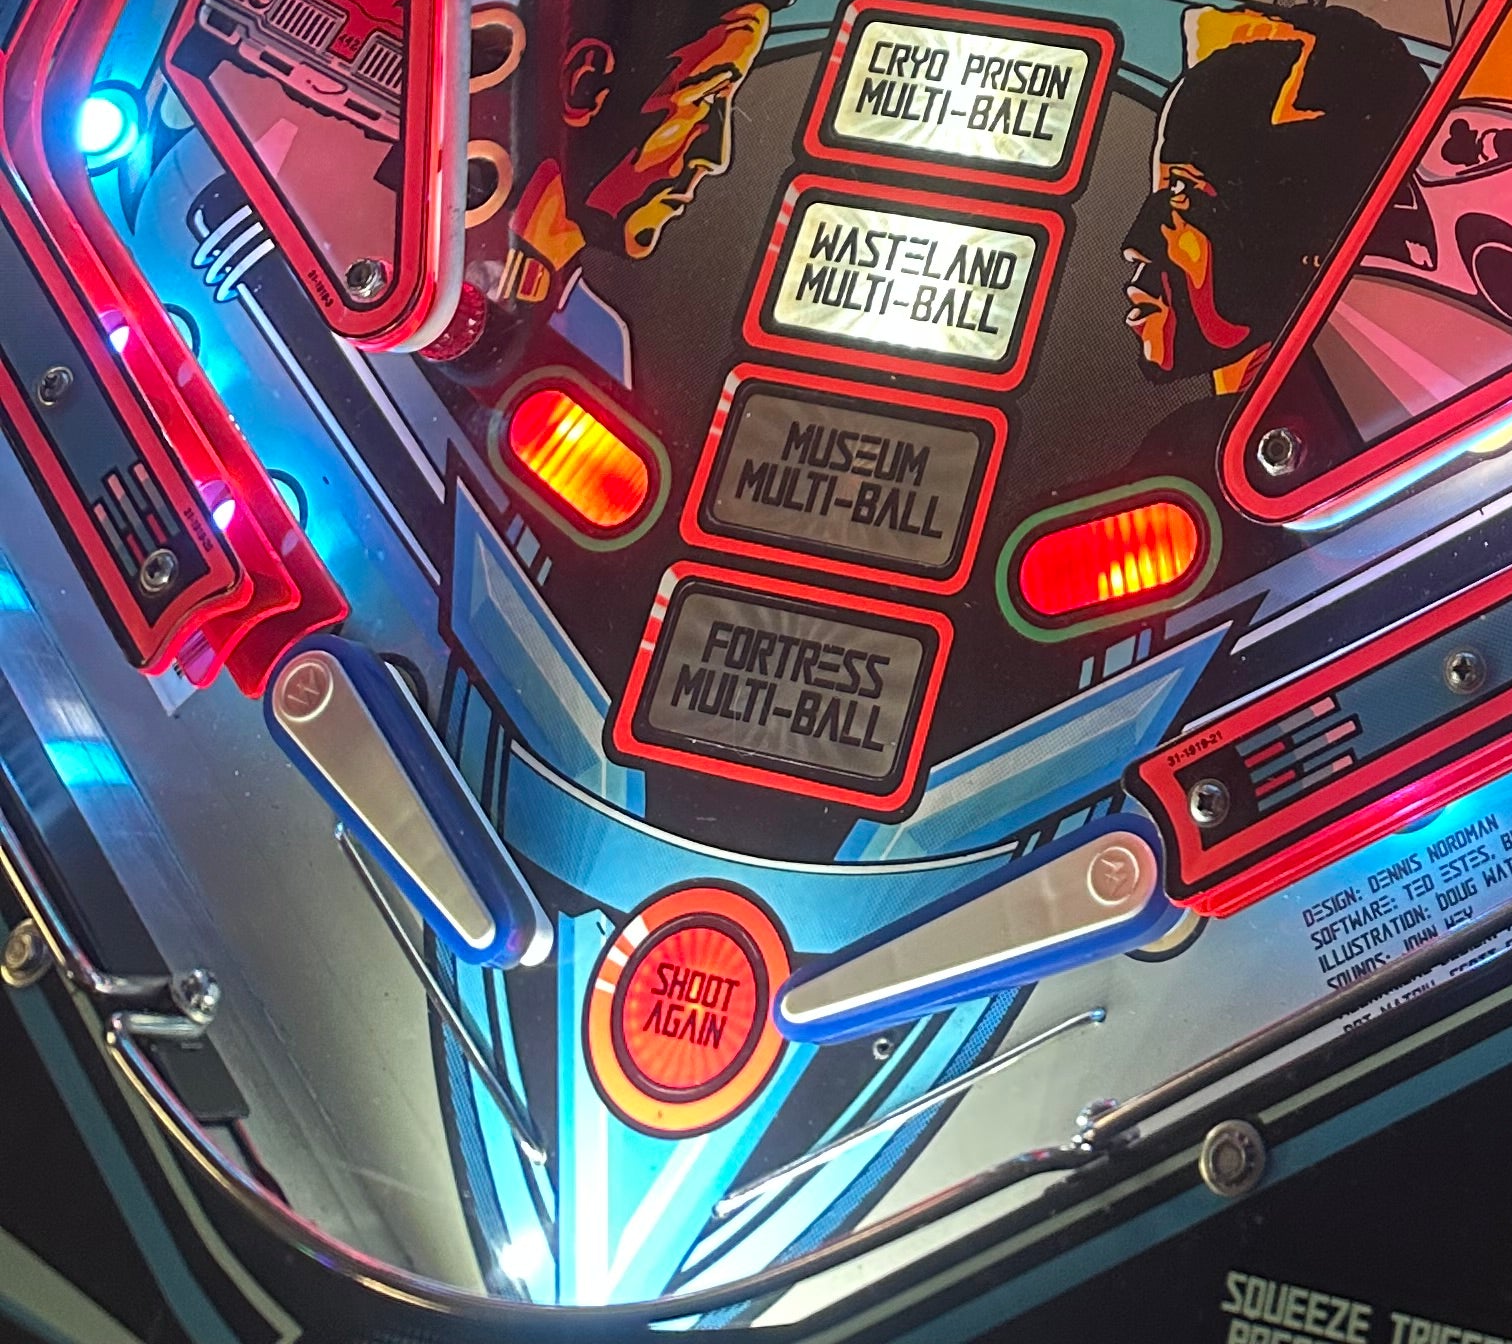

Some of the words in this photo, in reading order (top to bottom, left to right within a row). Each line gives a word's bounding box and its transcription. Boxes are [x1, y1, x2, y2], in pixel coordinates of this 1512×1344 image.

[867, 40, 950, 82] CRYO
[960, 52, 1073, 100] PRISON
[855, 77, 1054, 140] MULTI-BALL
[809, 222, 1018, 290] WASTELAND
[795, 268, 999, 333] MULTI-BALL
[780, 420, 931, 487] MUSEUM
[735, 458, 943, 539] MULTI-BALL
[701, 620, 891, 700] FORTRESS
[670, 663, 885, 753] MULTI-BALL
[1302, 886, 1364, 928] DESIGN:
[1367, 852, 1423, 894] DENNIS
[1426, 813, 1500, 863] NORDMAN
[1310, 895, 1399, 951] SOFTWARE:
[1402, 873, 1435, 901] TED
[1317, 904, 1433, 975] ILLUSTRATION:
[1435, 876, 1479, 912] DOUG
[651, 962, 741, 1012] SHOOT
[642, 999, 728, 1050] AGAIN
[1220, 1269, 1373, 1344] SQUEEZE
